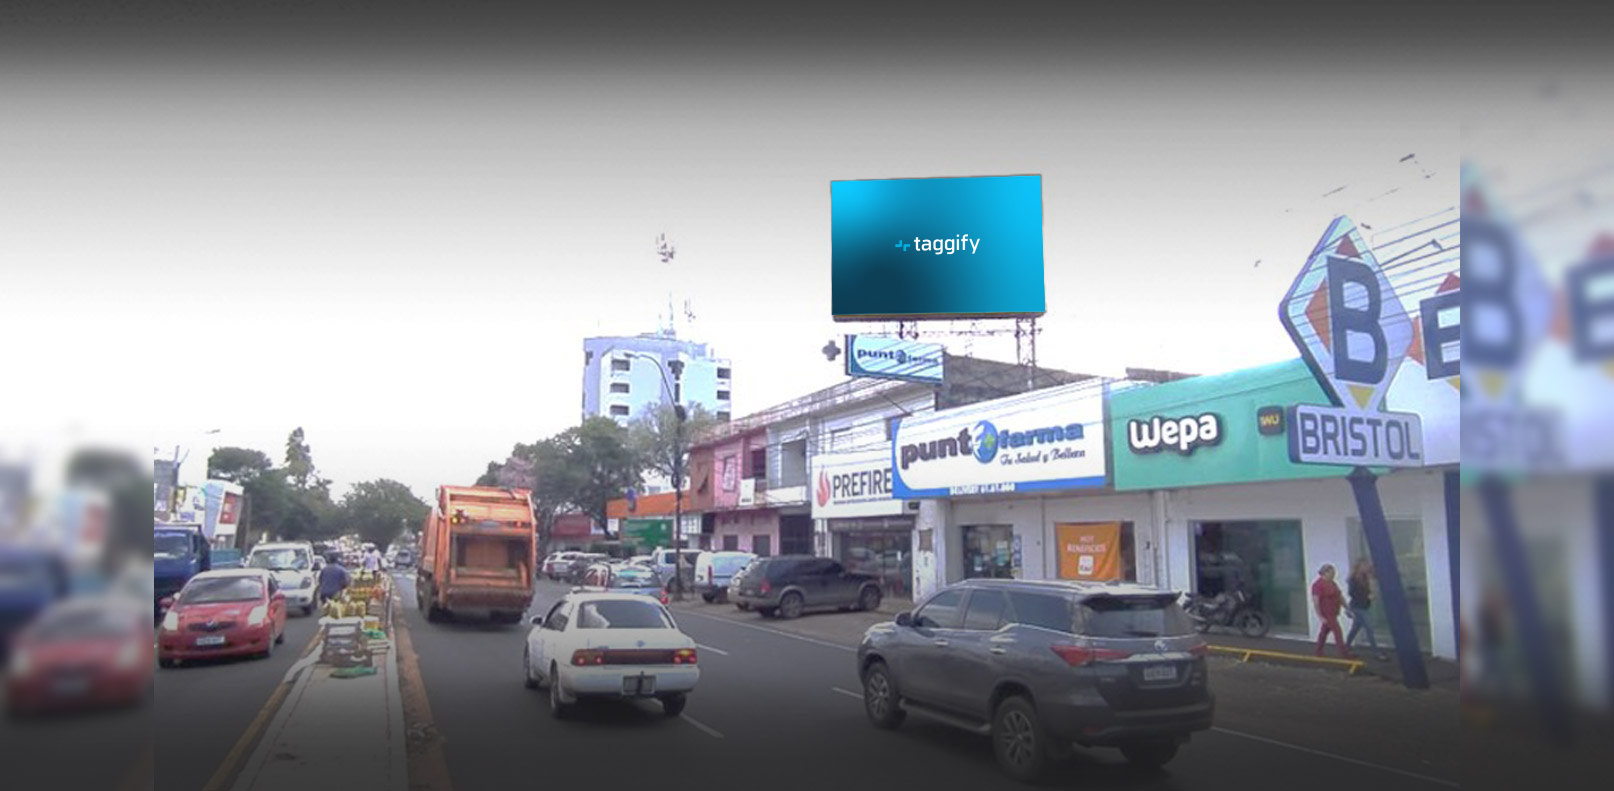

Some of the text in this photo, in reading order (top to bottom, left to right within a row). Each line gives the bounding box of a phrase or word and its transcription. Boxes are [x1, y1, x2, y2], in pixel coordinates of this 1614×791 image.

[913, 233, 980, 255] taggify
[1327, 256, 1388, 385] B
[1129, 414, 1218, 451] Wepa
[1299, 412, 1420, 460] BRISTOL
[833, 468, 892, 498] PREFIRE
